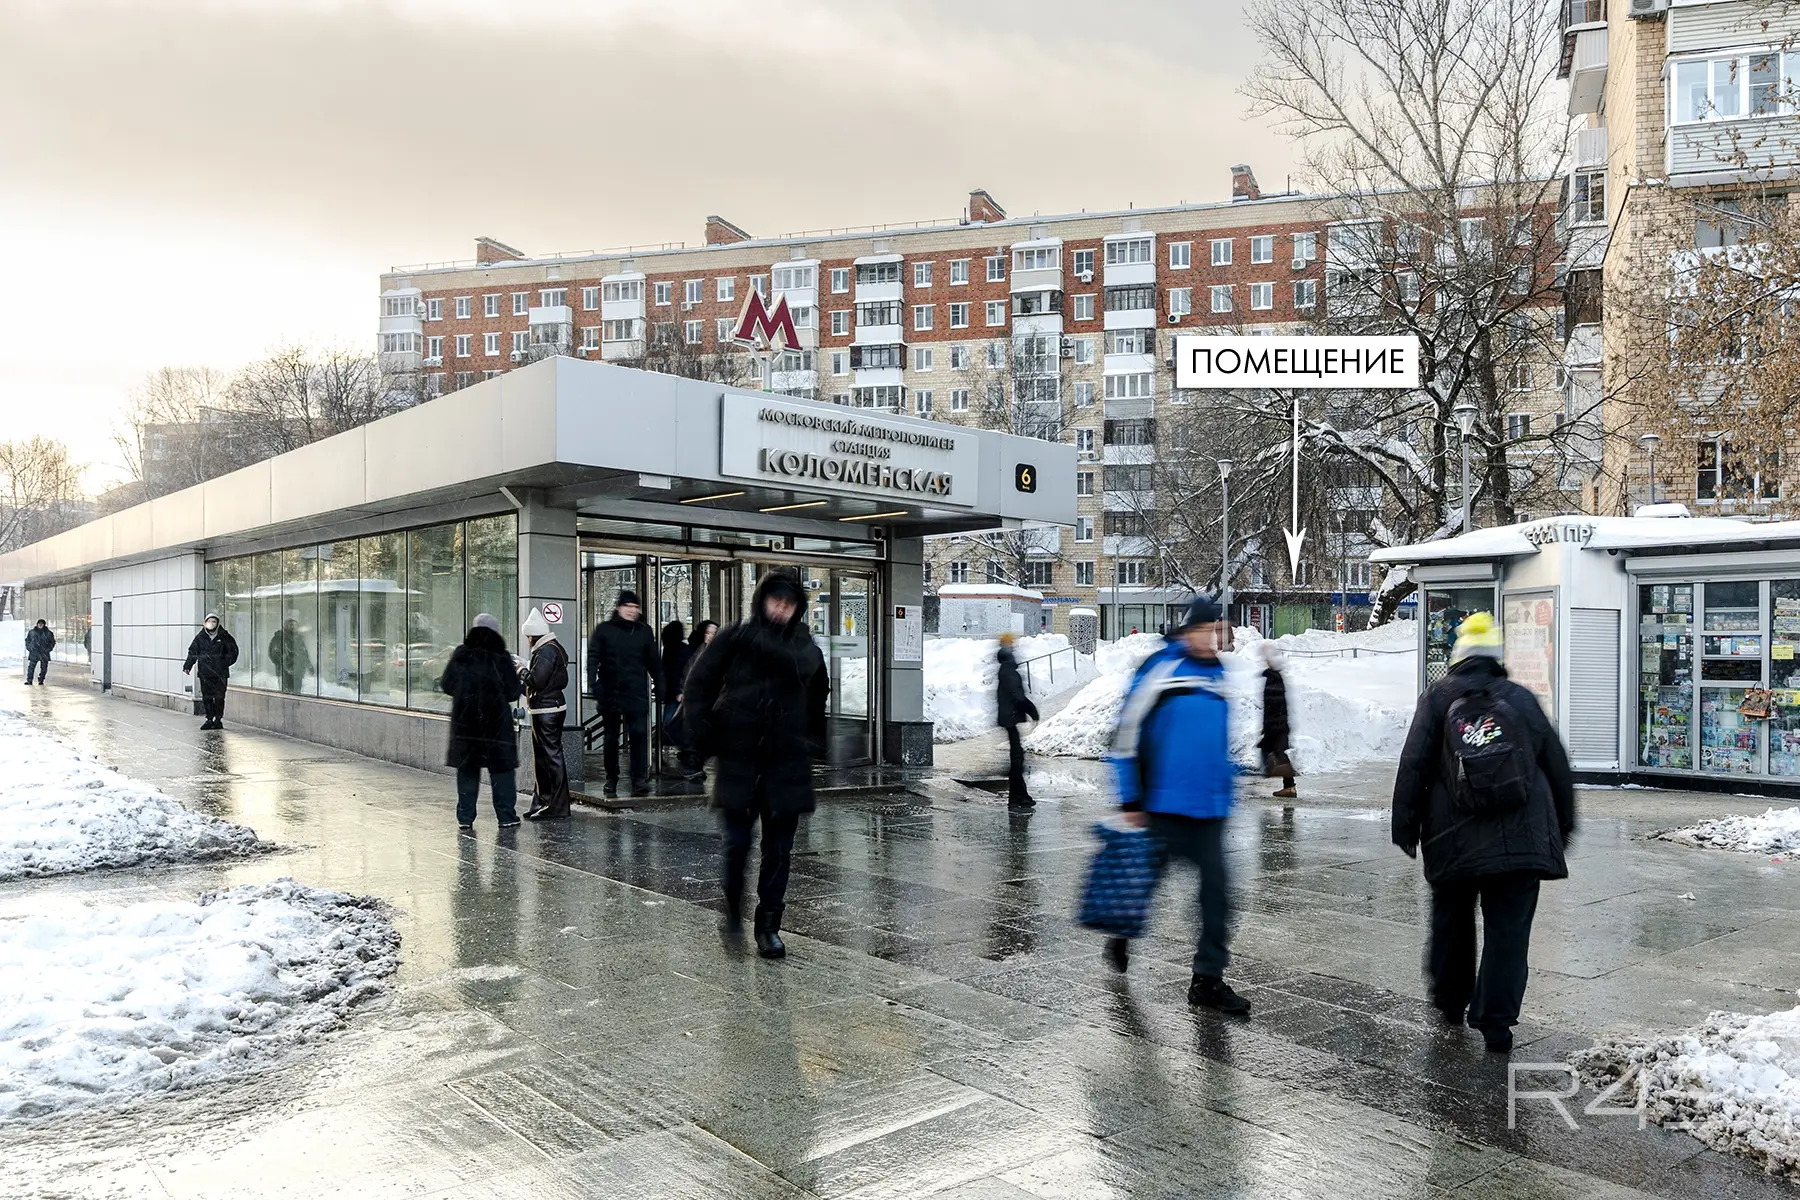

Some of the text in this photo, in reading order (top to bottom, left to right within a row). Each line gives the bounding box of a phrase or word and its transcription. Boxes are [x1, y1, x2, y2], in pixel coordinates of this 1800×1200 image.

[759, 408, 955, 450] МОСКОВСКИЙ МЕТРОПОЛИТЕН
[832, 439, 892, 459] СТАНЦИЯ
[760, 447, 954, 496] КОЛОМЕНСКАЯ
[1021, 468, 1031, 485] 6
